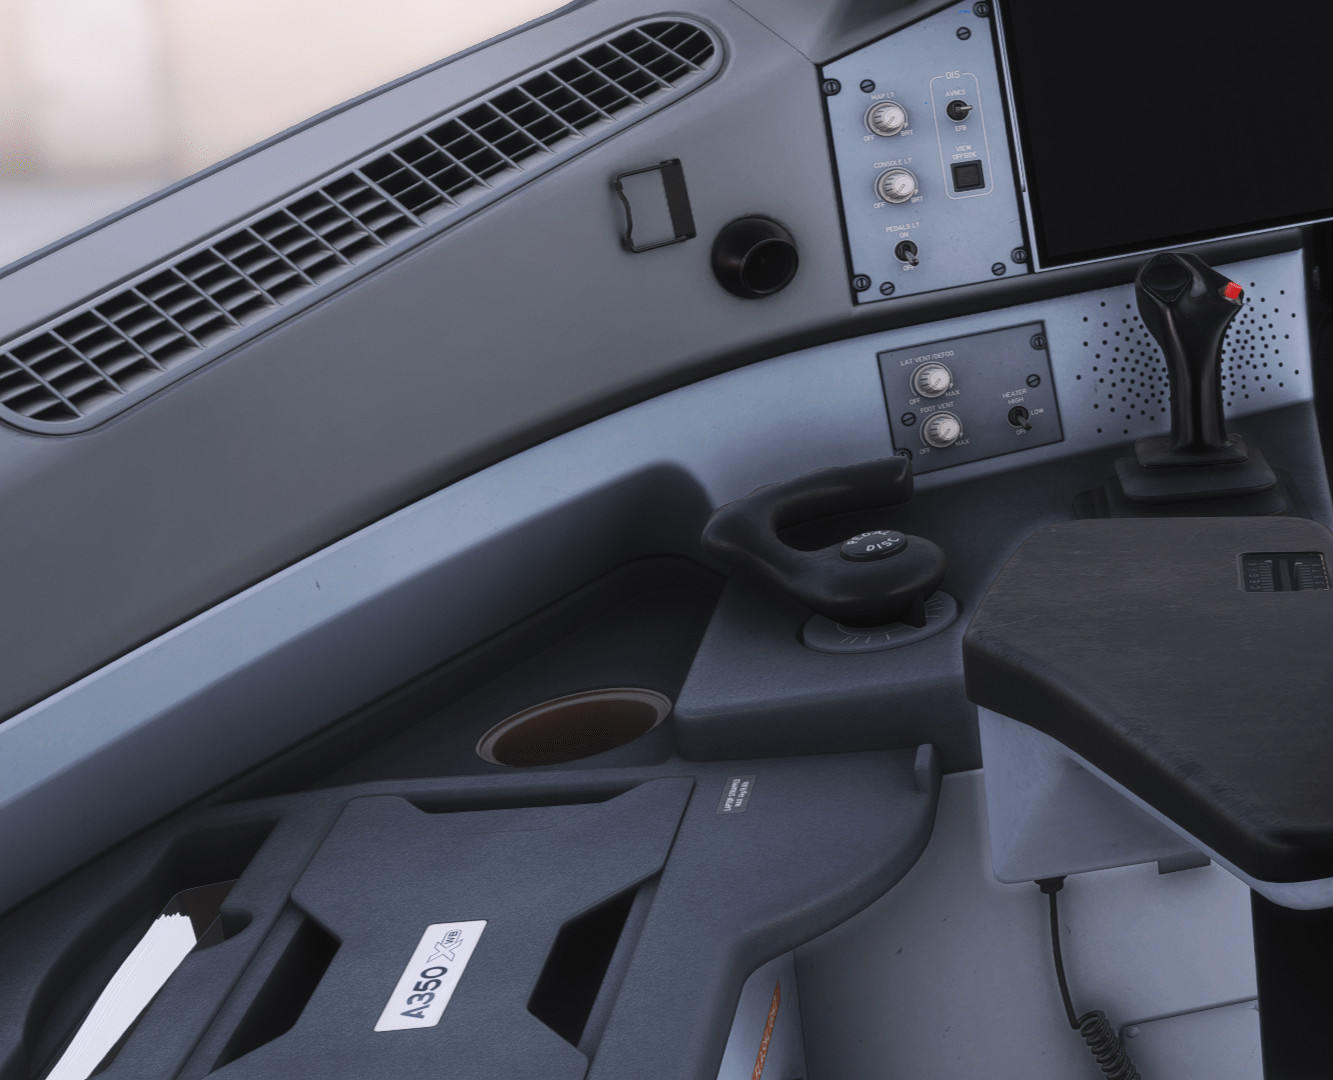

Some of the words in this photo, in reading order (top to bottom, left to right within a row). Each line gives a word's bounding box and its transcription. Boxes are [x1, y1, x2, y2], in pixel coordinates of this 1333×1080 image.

[945, 71, 961, 79] OIS
[945, 89, 966, 97] AVNCS
[900, 129, 913, 137] BRT
[873, 160, 900, 168] CONSOLE
[885, 224, 909, 232] PEDALS
[900, 358, 913, 366] LAT
[914, 350, 955, 363] VENT/DEFOG
[1002, 389, 1027, 399] HEATER
[909, 397, 921, 405] OFF
[1008, 397, 1024, 405] HIGH
[920, 405, 936, 414] FOOT
[937, 401, 954, 410] VENT
[1030, 408, 1044, 416] LOW
[1016, 428, 1026, 436] OFF
[919, 447, 931, 455] OFF
[846, 530, 891, 545] PEDAL
[866, 537, 900, 551] DISC
[723, 797, 734, 811] LAPTOP
[400, 966, 448, 1019] A350
